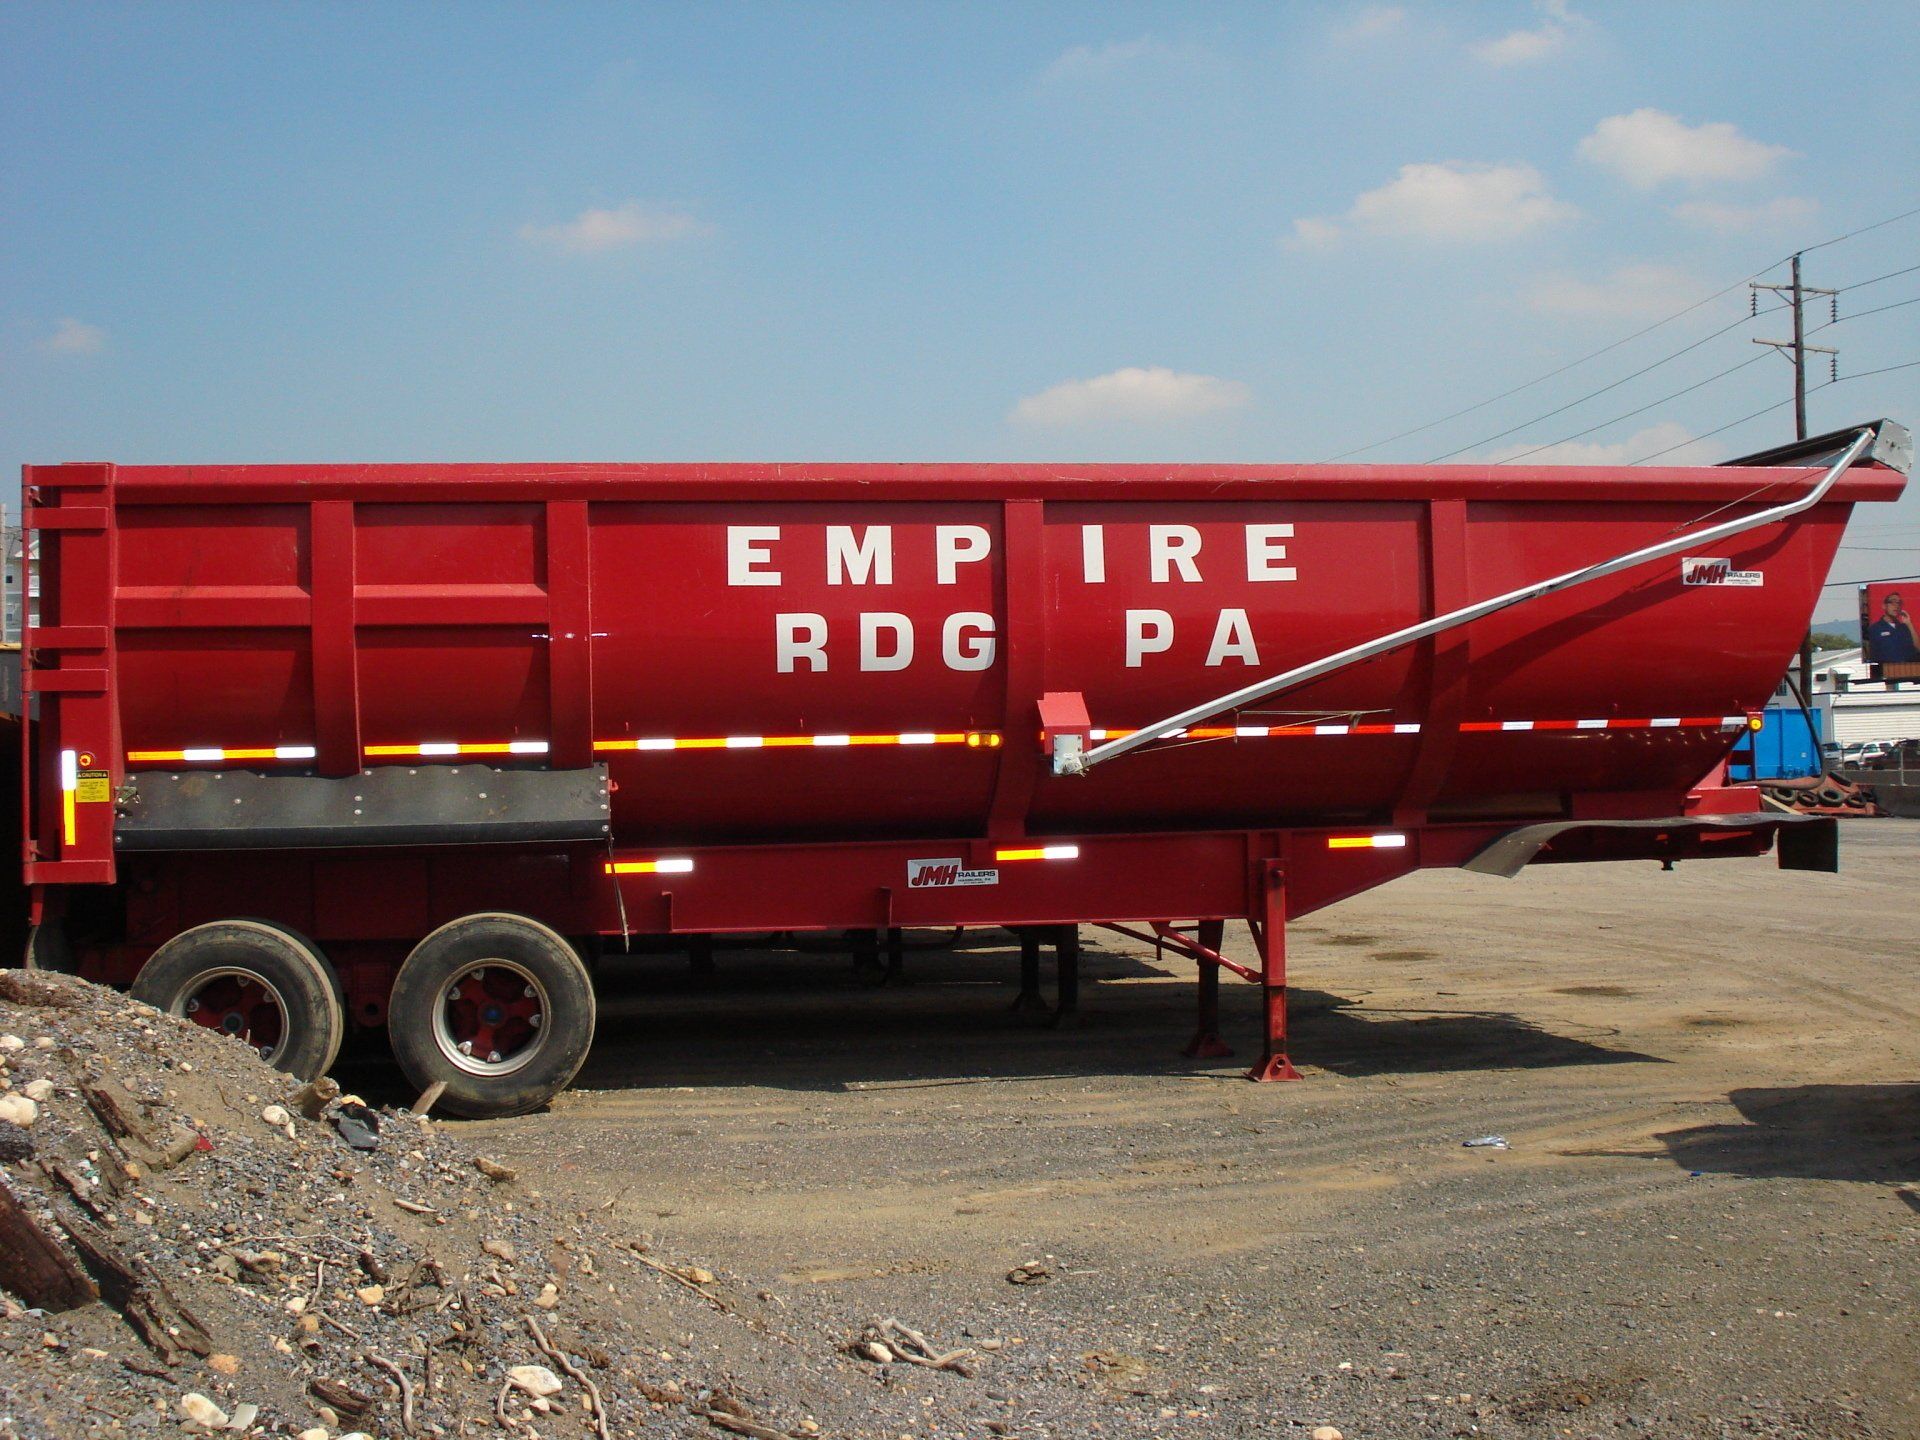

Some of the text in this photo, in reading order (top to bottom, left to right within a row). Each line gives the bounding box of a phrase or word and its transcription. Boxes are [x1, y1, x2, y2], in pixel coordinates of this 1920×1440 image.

[727, 524, 1297, 586] EMPIRE
[1686, 564, 1728, 584] JMH
[776, 608, 1261, 673] RDG PA
[911, 864, 959, 886] JMH
